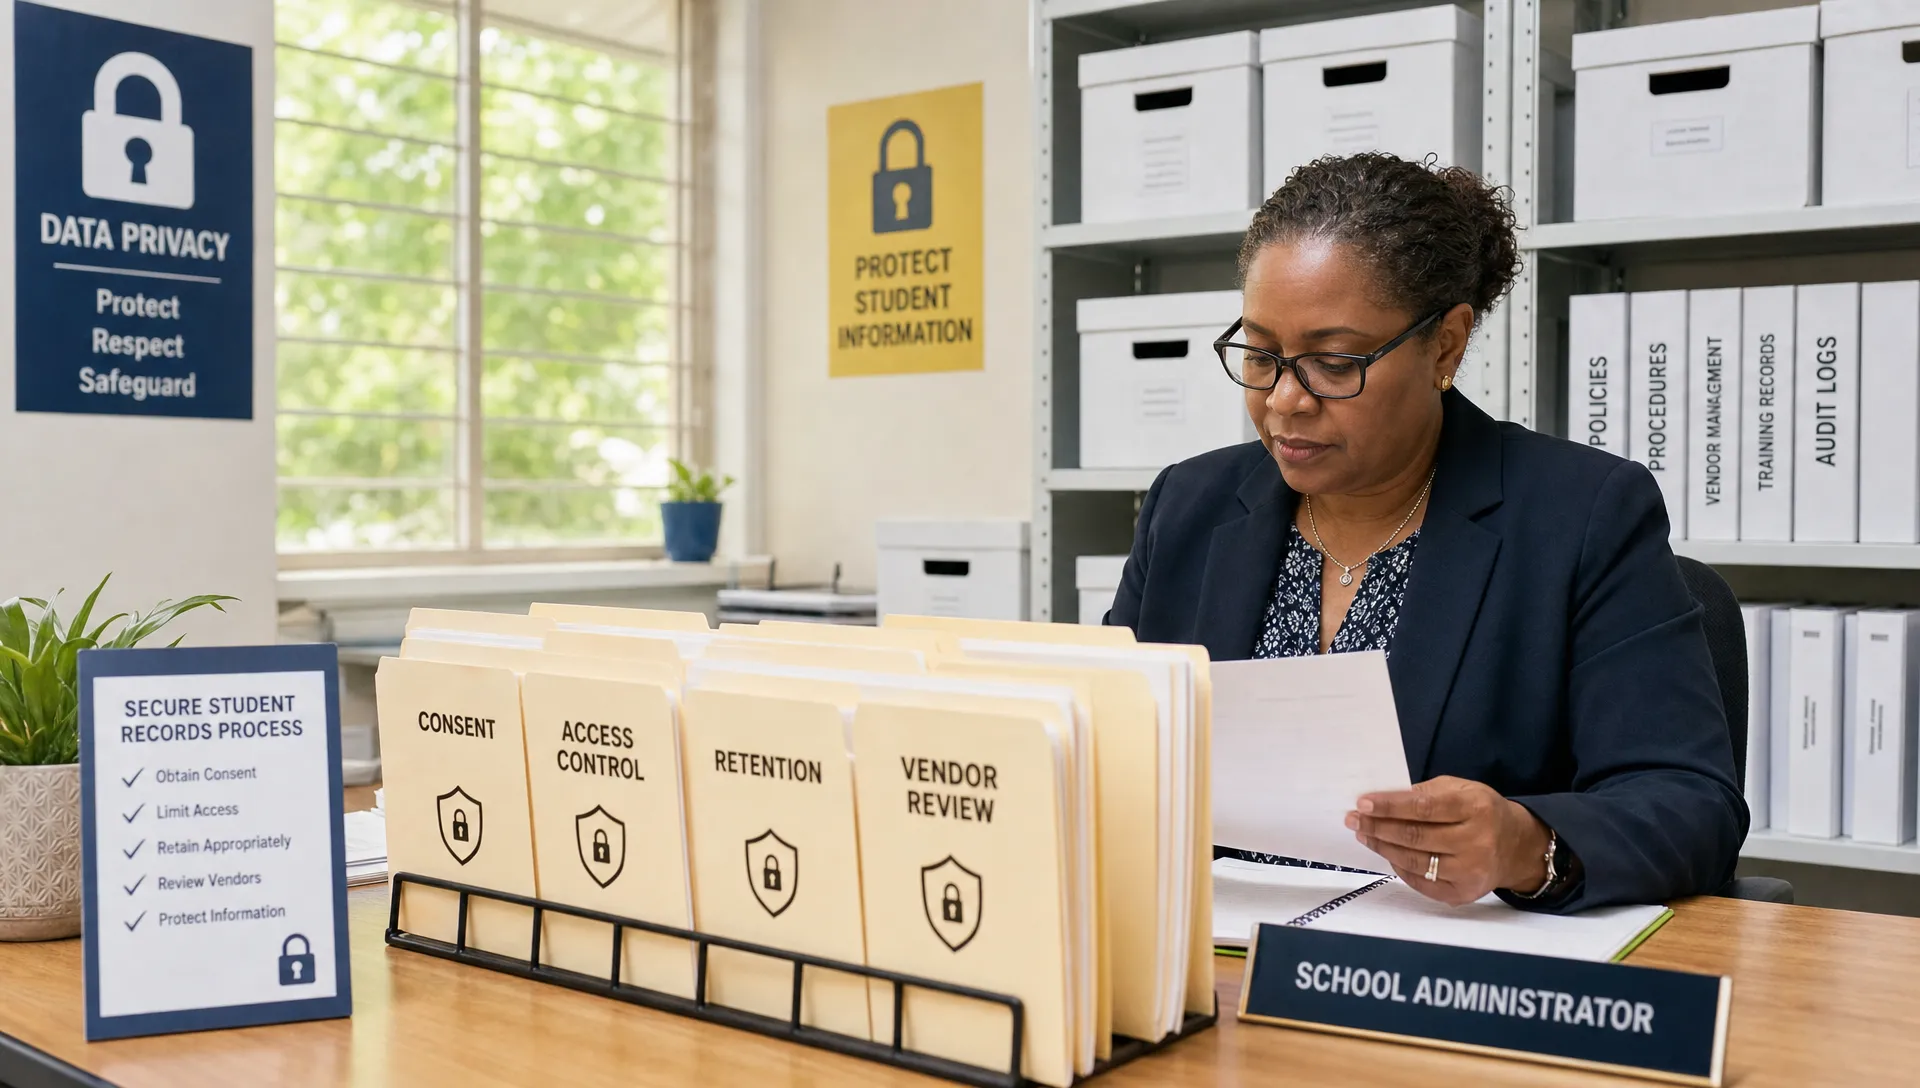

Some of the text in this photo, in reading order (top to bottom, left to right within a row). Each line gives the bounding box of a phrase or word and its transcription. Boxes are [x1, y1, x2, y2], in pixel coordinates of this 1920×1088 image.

[41, 212, 230, 262] DATA PRIVACY
[855, 247, 952, 280] PROTECT
[96, 288, 181, 320] Protect
[855, 283, 952, 315] STUDENT
[92, 327, 185, 361] Respect
[838, 318, 973, 350] INFORMATION
[78, 366, 197, 401] Safeguard
[1589, 355, 1607, 446] POLICIES
[1648, 342, 1667, 471] PROCEDURES
[1758, 333, 1775, 492] TRAINING RECORDS
[1816, 336, 1837, 467] AUDIT LOGS
[1706, 443, 1721, 506] VENDOR
[125, 695, 295, 717] SECURE STUDENT
[121, 720, 303, 743] RECORDS PROCESS
[418, 711, 496, 740] CONSENT
[562, 720, 634, 749] ACCESS
[156, 766, 257, 784] Obtain Consent
[557, 750, 645, 781] CONTROL
[714, 749, 822, 784] RETENTION
[901, 756, 998, 790] VENDOR
[156, 803, 239, 819] Limit Access
[907, 790, 994, 824] REVIEW
[157, 834, 292, 855] Retain Appropriately
[158, 872, 262, 891] Review Vendors
[159, 906, 286, 927] Protect Information
[1295, 961, 1655, 1034] SCHOOL ADMINISTRATOR
